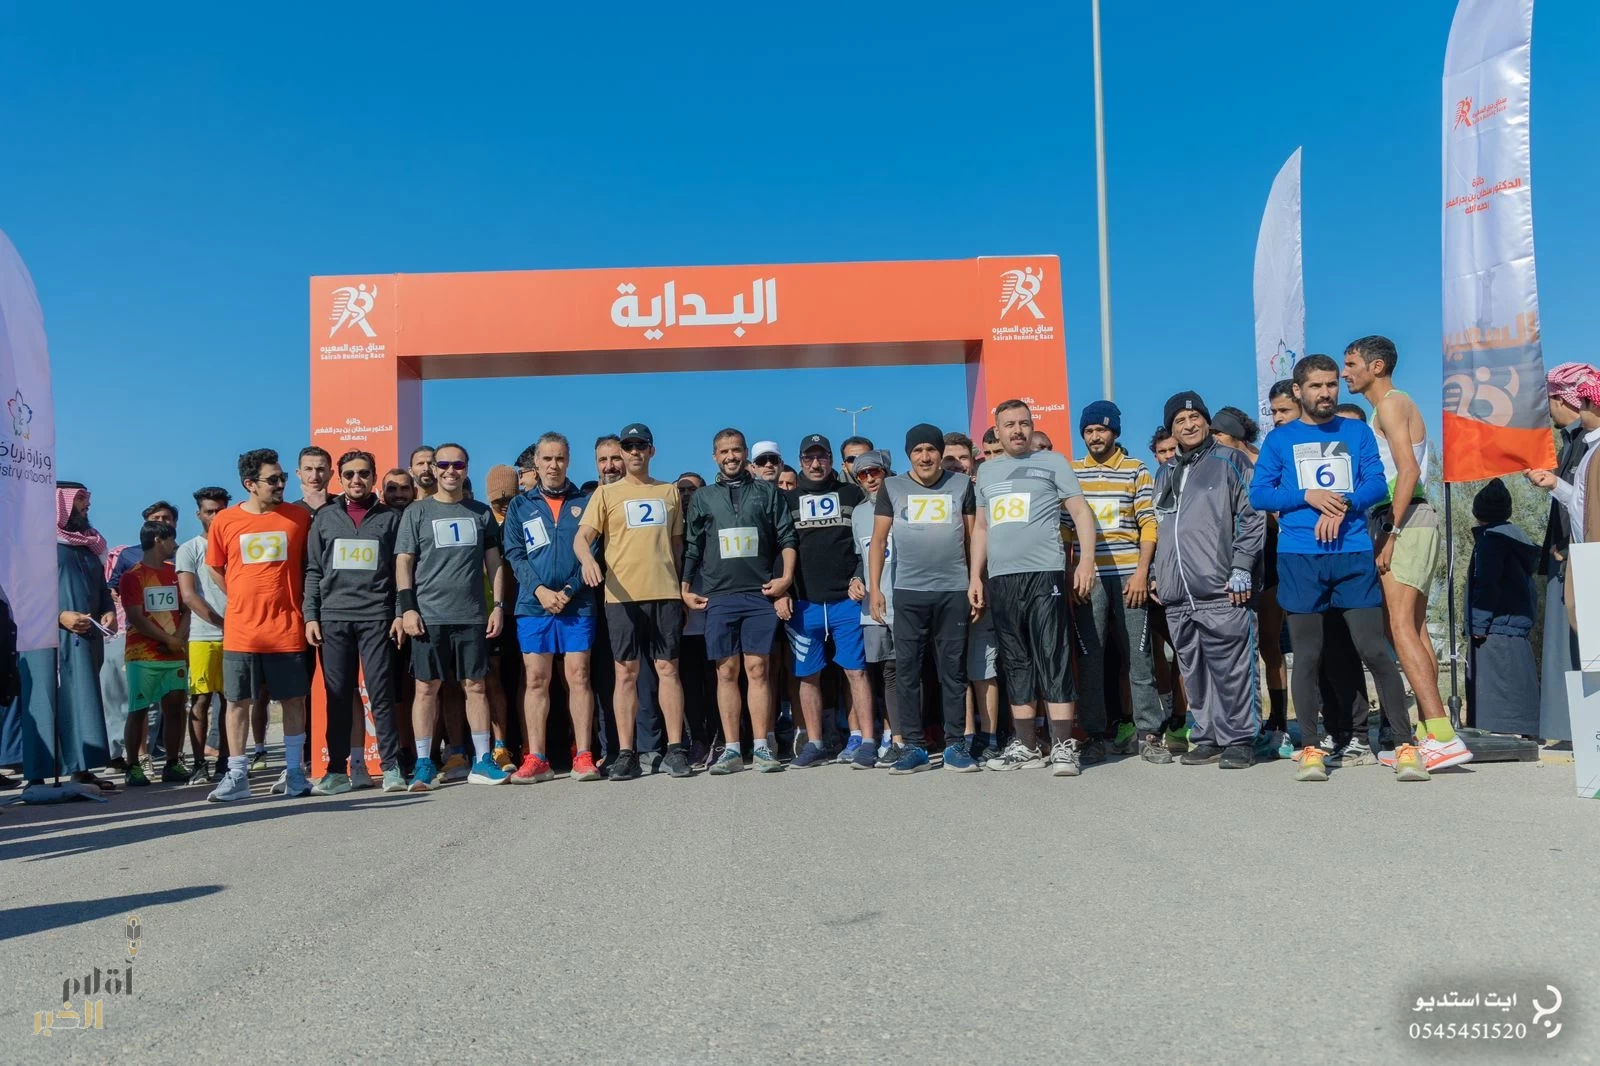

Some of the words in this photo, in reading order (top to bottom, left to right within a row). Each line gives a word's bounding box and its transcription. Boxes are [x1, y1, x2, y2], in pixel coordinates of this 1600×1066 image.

[610, 278, 777, 340] البداية
[1020, 326, 1033, 334] جري
[1035, 324, 1054, 334] سباق
[349, 344, 364, 353] جري
[366, 343, 385, 352] سباق
[372, 425, 392, 433] الدكتور
[27, 448, 52, 470] وزارة
[1316, 463, 1335, 487] 6
[639, 504, 654, 522] 2
[807, 498, 834, 516] 19
[912, 498, 946, 520] 73
[993, 498, 1024, 521] 68
[1089, 504, 1114, 525] 4
[450, 523, 459, 541] 1
[248, 536, 282, 560] 63
[723, 536, 751, 552] 111
[339, 547, 374, 561] 140
[148, 592, 174, 606] 176
